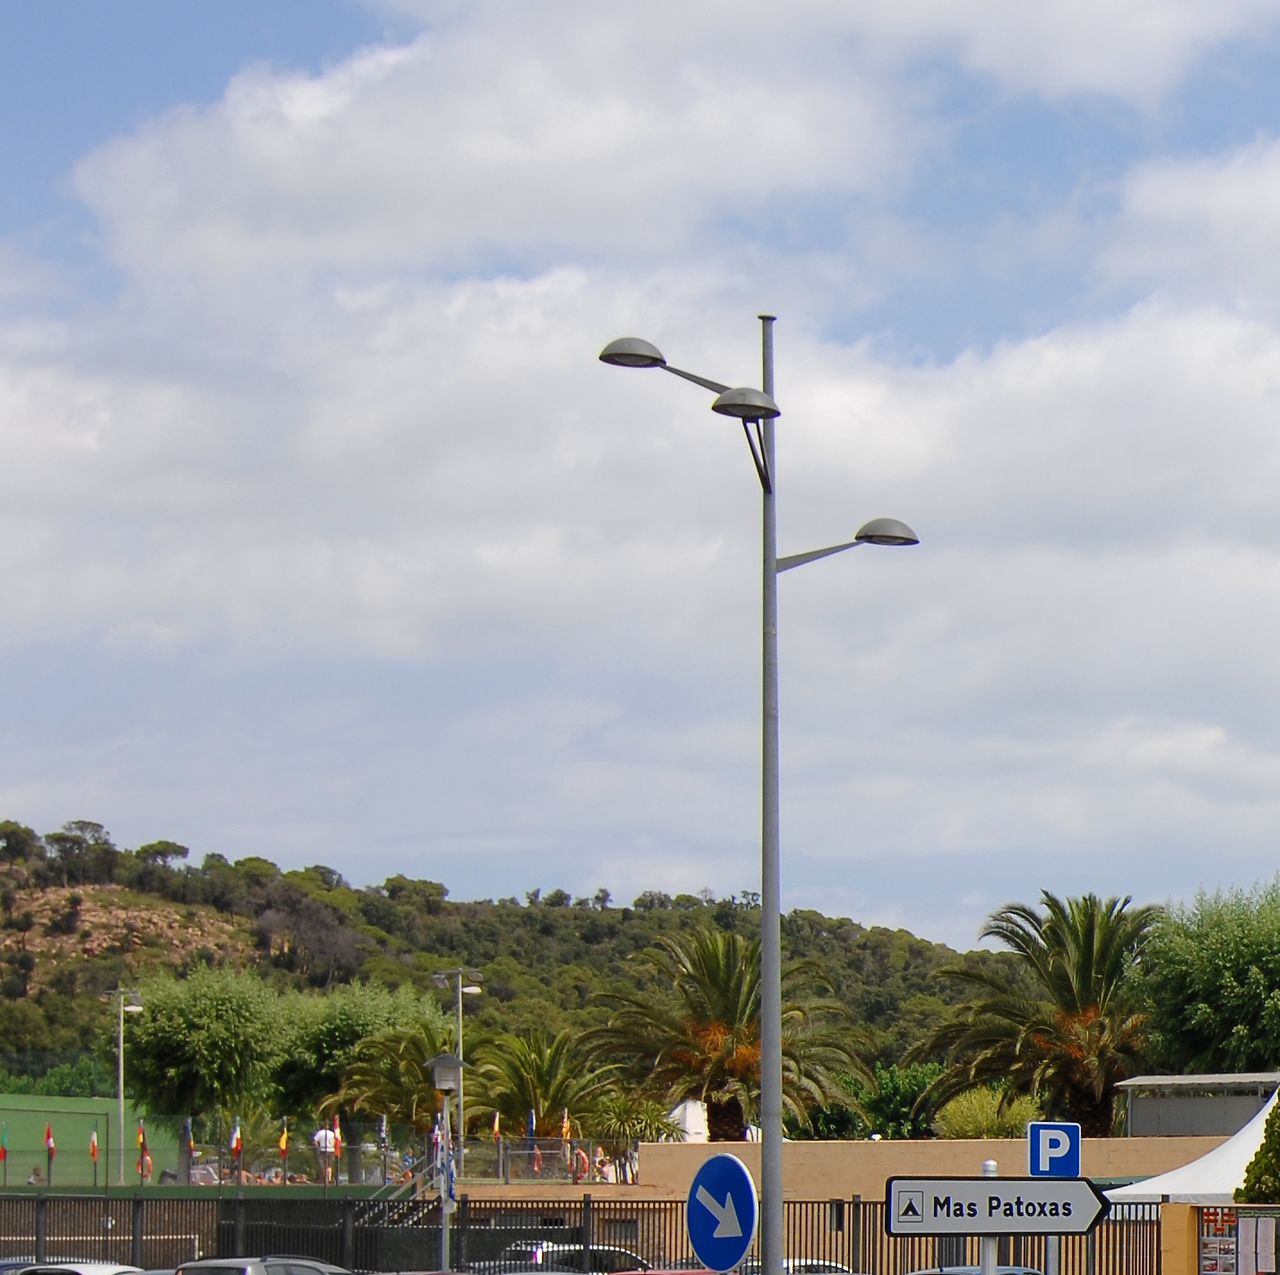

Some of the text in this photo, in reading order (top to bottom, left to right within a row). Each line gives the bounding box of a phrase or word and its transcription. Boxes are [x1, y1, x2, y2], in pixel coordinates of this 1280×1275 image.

[1039, 1129, 1071, 1172] P
[933, 1196, 1072, 1217] Mas Patoxas
